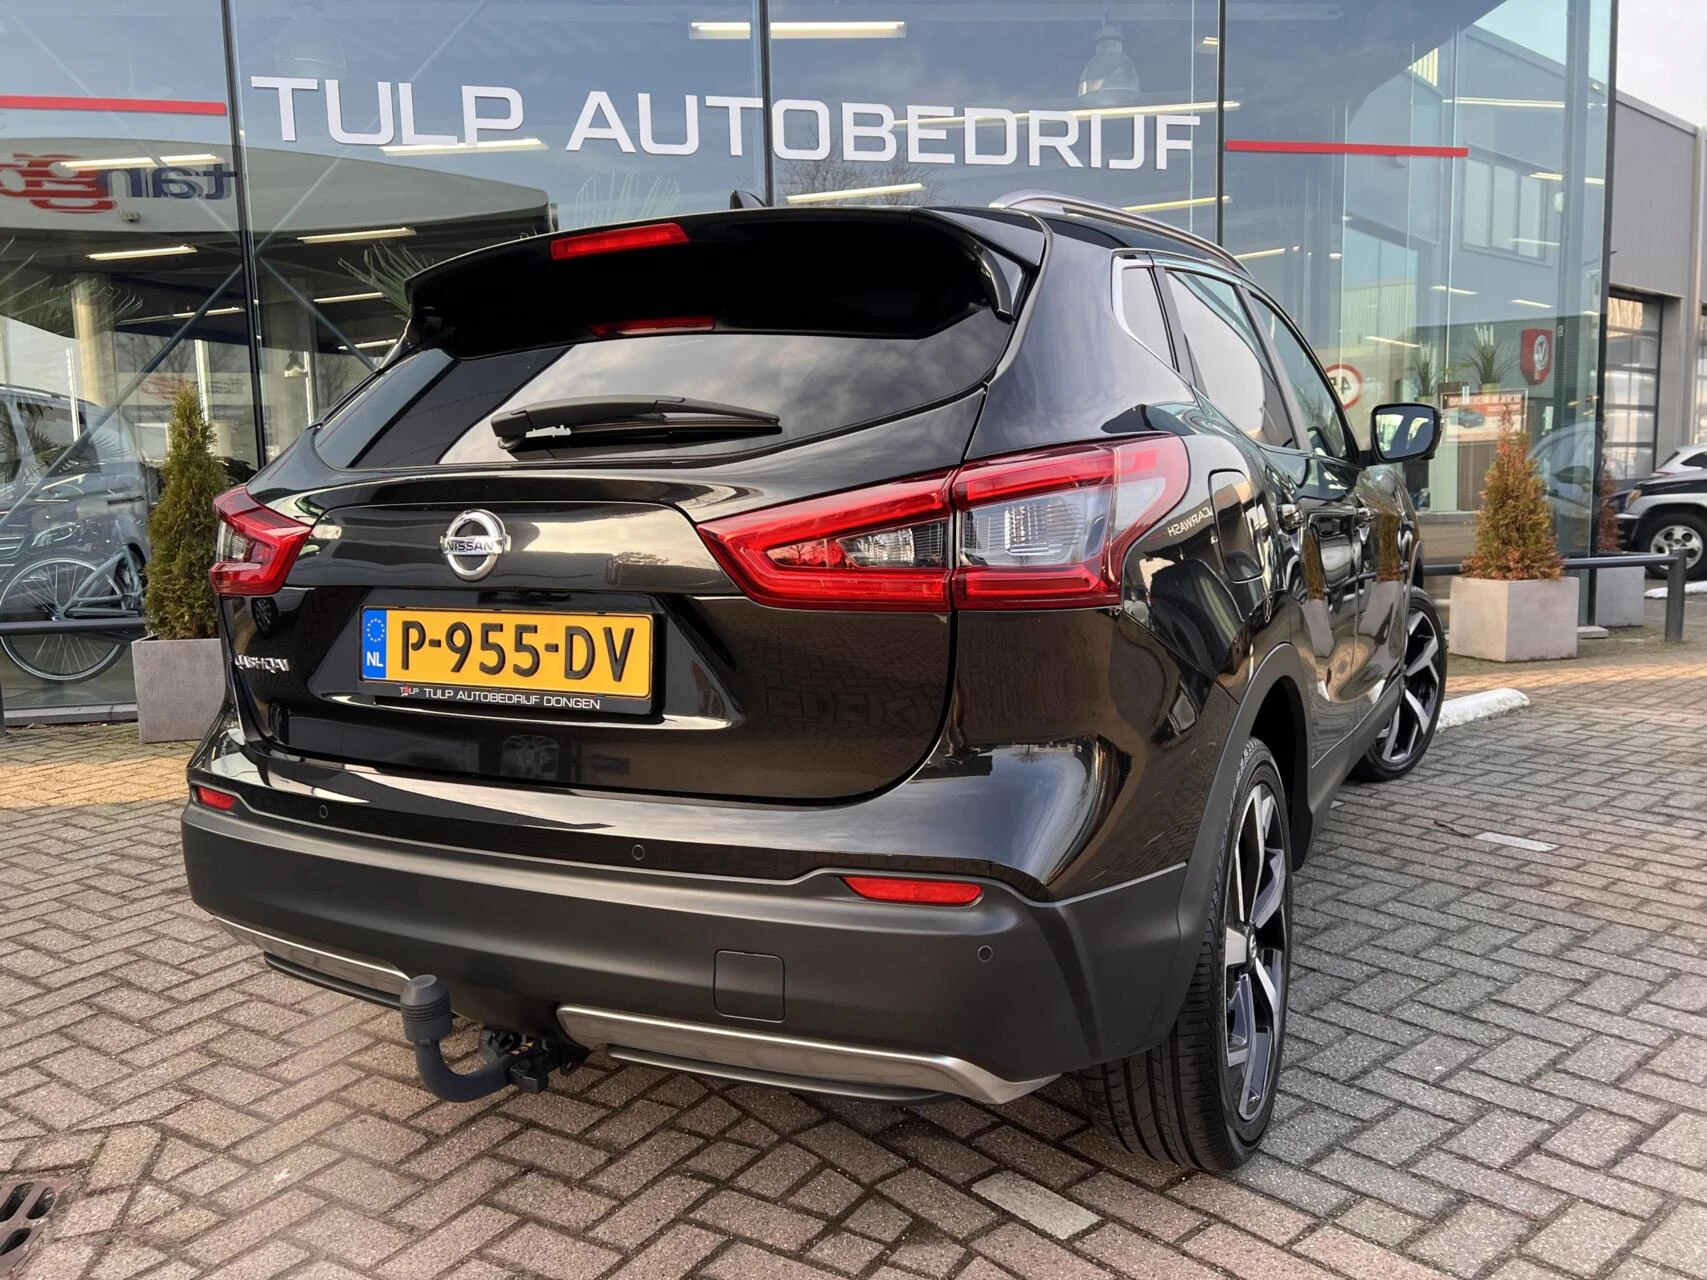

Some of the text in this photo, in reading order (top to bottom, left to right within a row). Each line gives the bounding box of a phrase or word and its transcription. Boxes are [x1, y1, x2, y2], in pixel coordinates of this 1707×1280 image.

[250, 76, 1201, 171] TULP AUTOBEDRIJF
[446, 540, 494, 551] NISSAN
[366, 651, 384, 668] NL
[401, 620, 635, 683] P-955-DV
[424, 688, 601, 710] TULP AUTOBEDRIJF DONGEN
